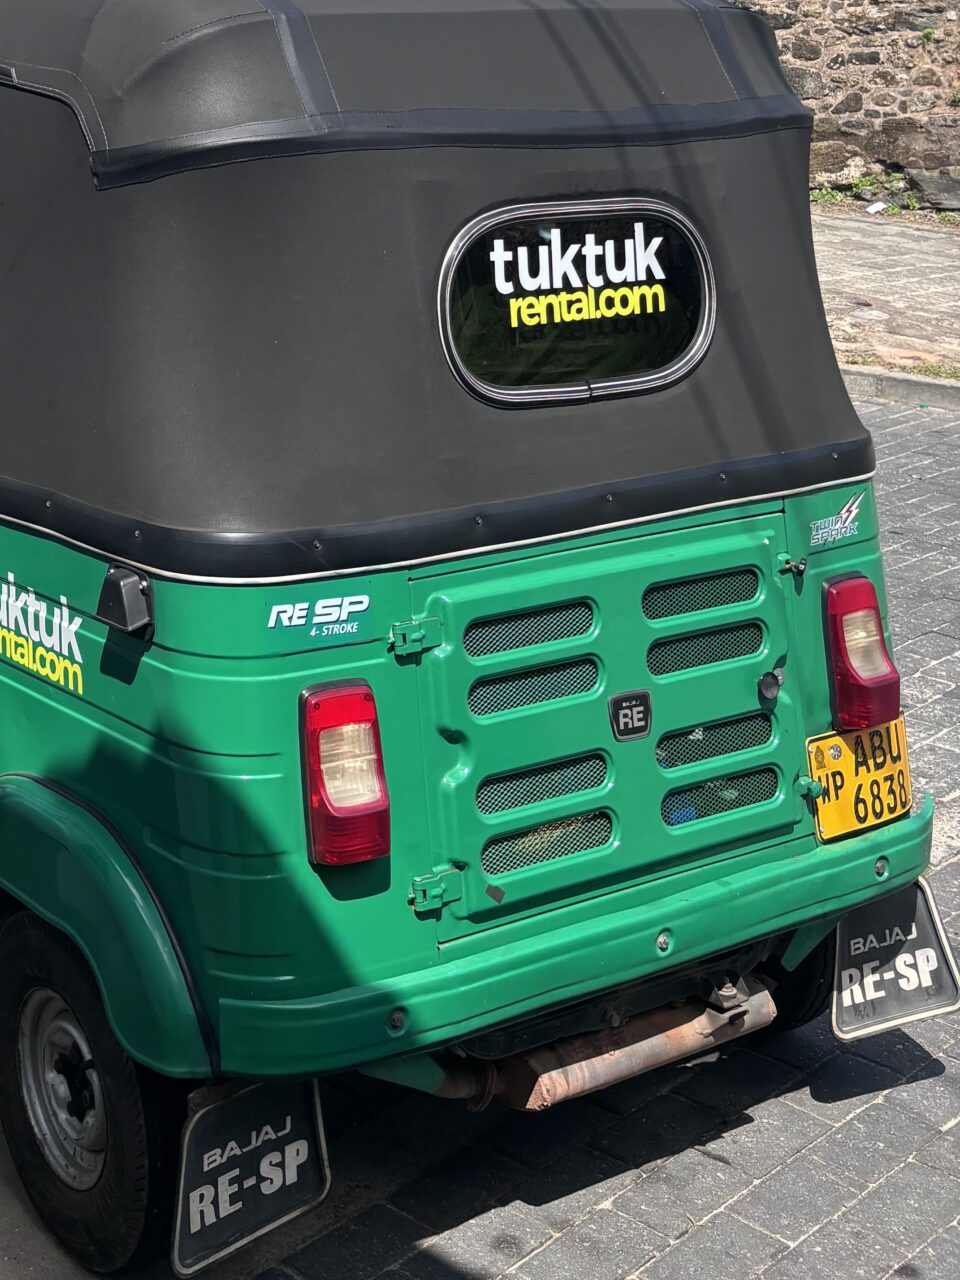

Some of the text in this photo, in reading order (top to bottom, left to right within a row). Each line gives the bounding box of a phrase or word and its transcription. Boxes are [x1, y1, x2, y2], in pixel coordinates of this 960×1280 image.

[490, 222, 666, 295] tuktuk
[509, 284, 666, 328] rental.com
[809, 521, 859, 546] SPARK
[267, 594, 370, 629] RE SP
[321, 621, 359, 636] STROKE
[618, 705, 646, 730] RE
[854, 722, 902, 778] ABU
[818, 768, 908, 824] WP 6838
[849, 922, 918, 956] BAJAJ
[841, 947, 939, 1008] RE-SP
[203, 1115, 292, 1173] BAJAJ
[189, 1139, 309, 1235] RE-SP
